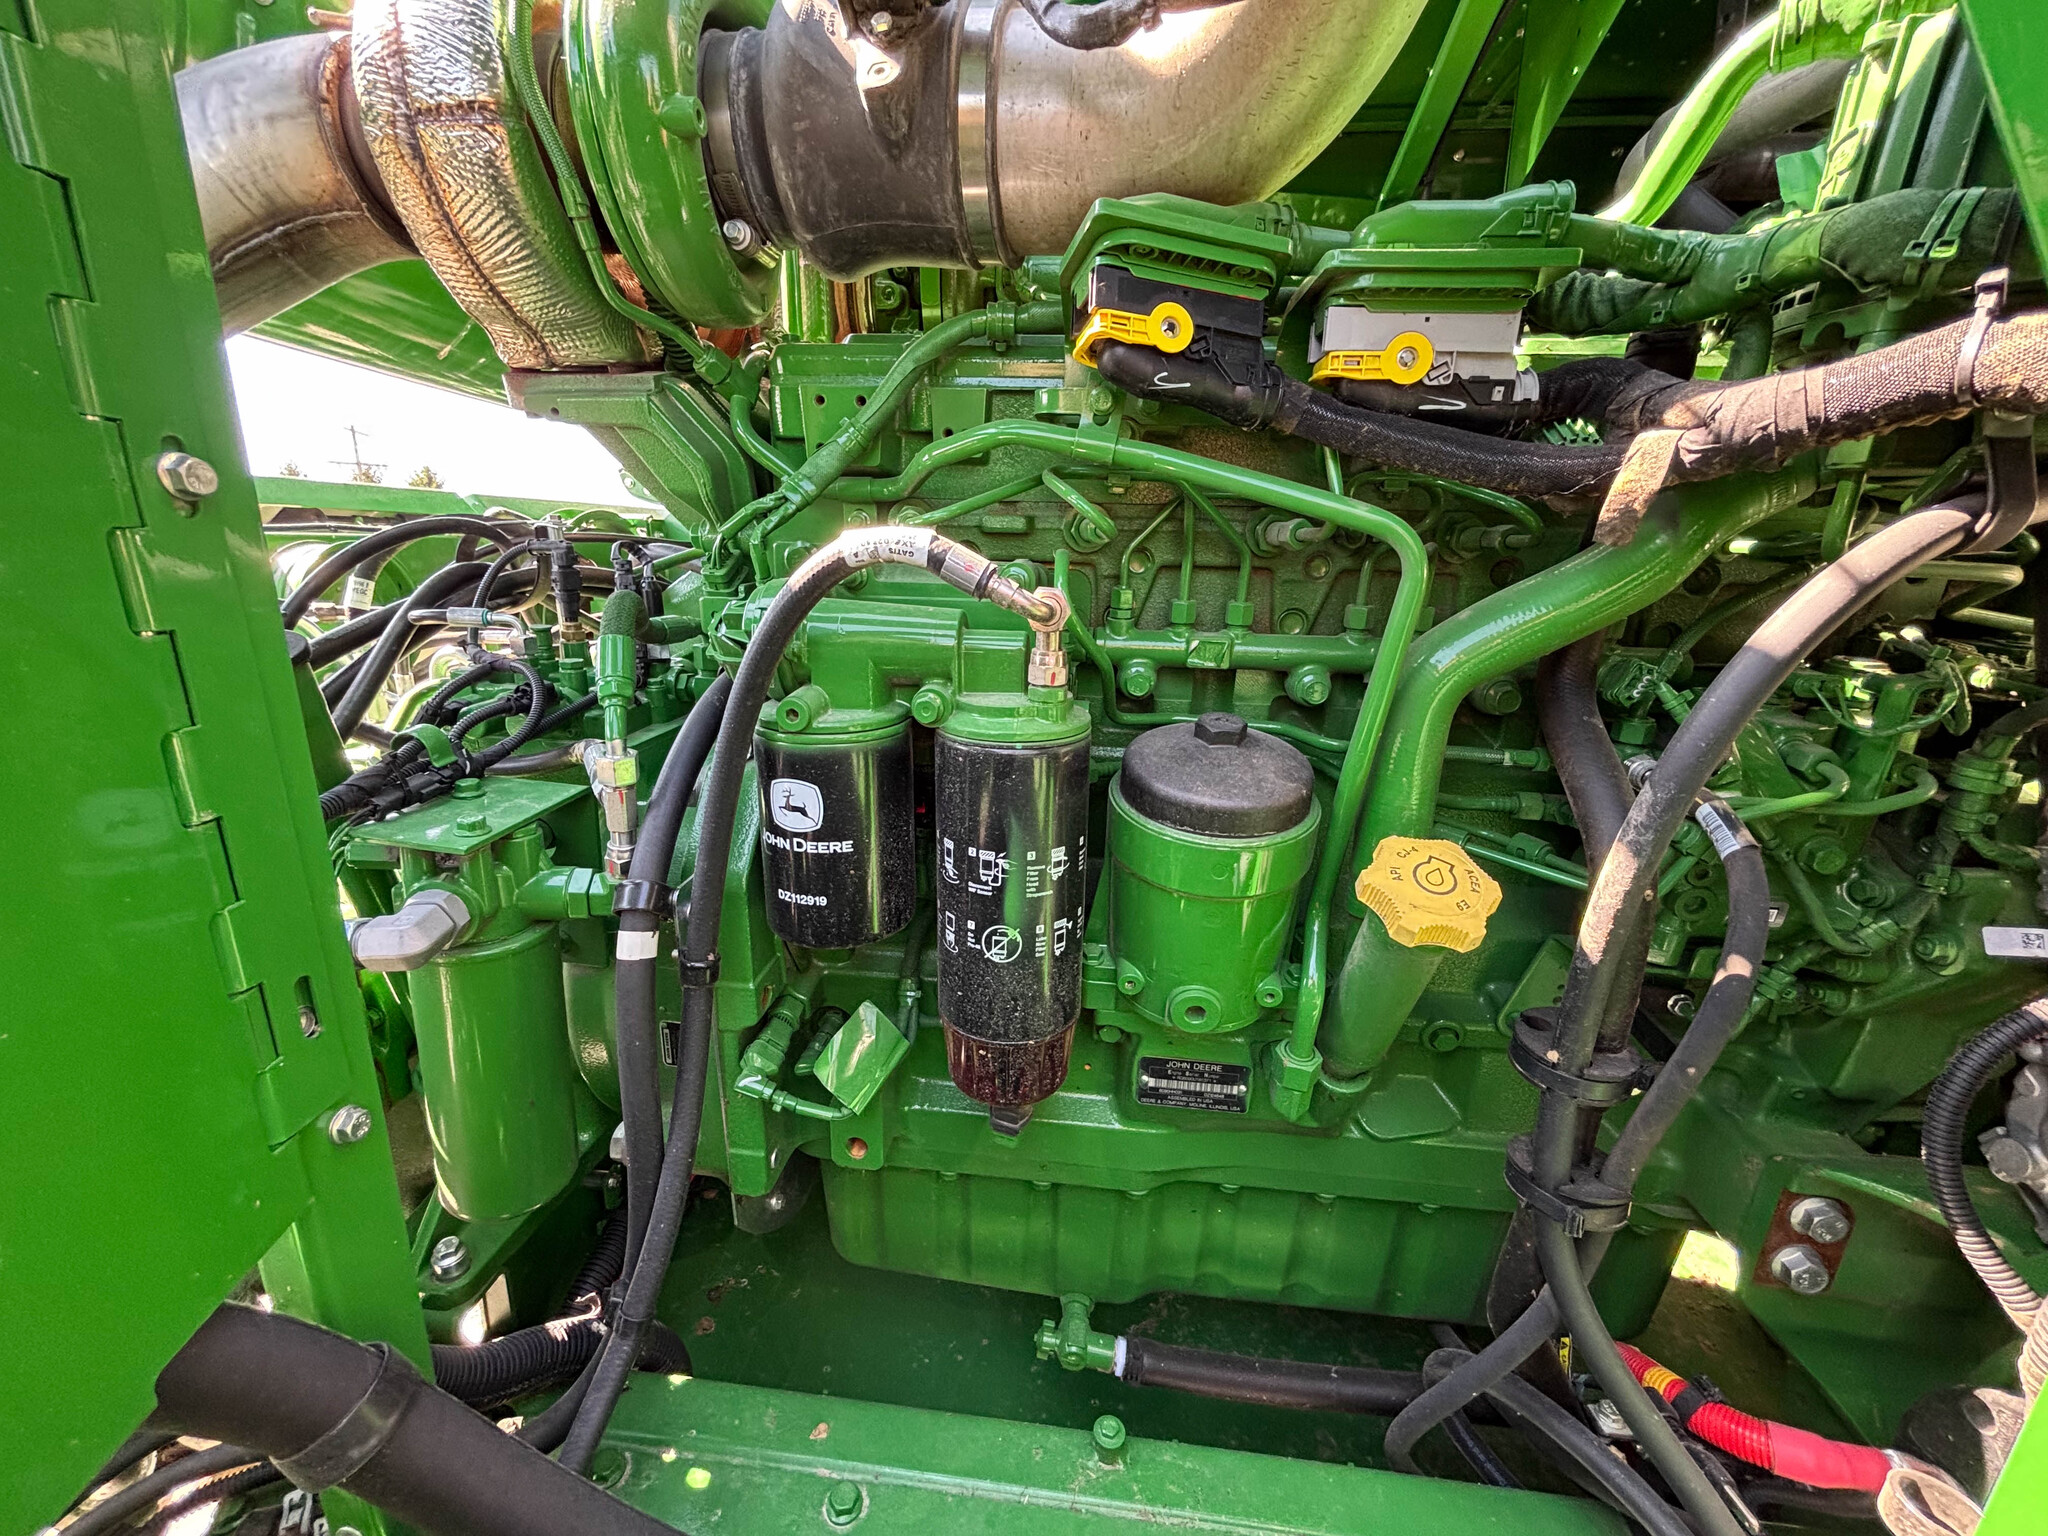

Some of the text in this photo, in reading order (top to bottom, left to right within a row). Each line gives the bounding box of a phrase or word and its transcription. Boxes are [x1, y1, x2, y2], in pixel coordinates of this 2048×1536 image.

[793, 837, 854, 854] DEERE
[1389, 846, 1419, 881] API CJ-4
[1464, 868, 1481, 894] ACEA
[778, 888, 827, 906] DZ112919
[1166, 1061, 1223, 1072] JOHN DEERE
